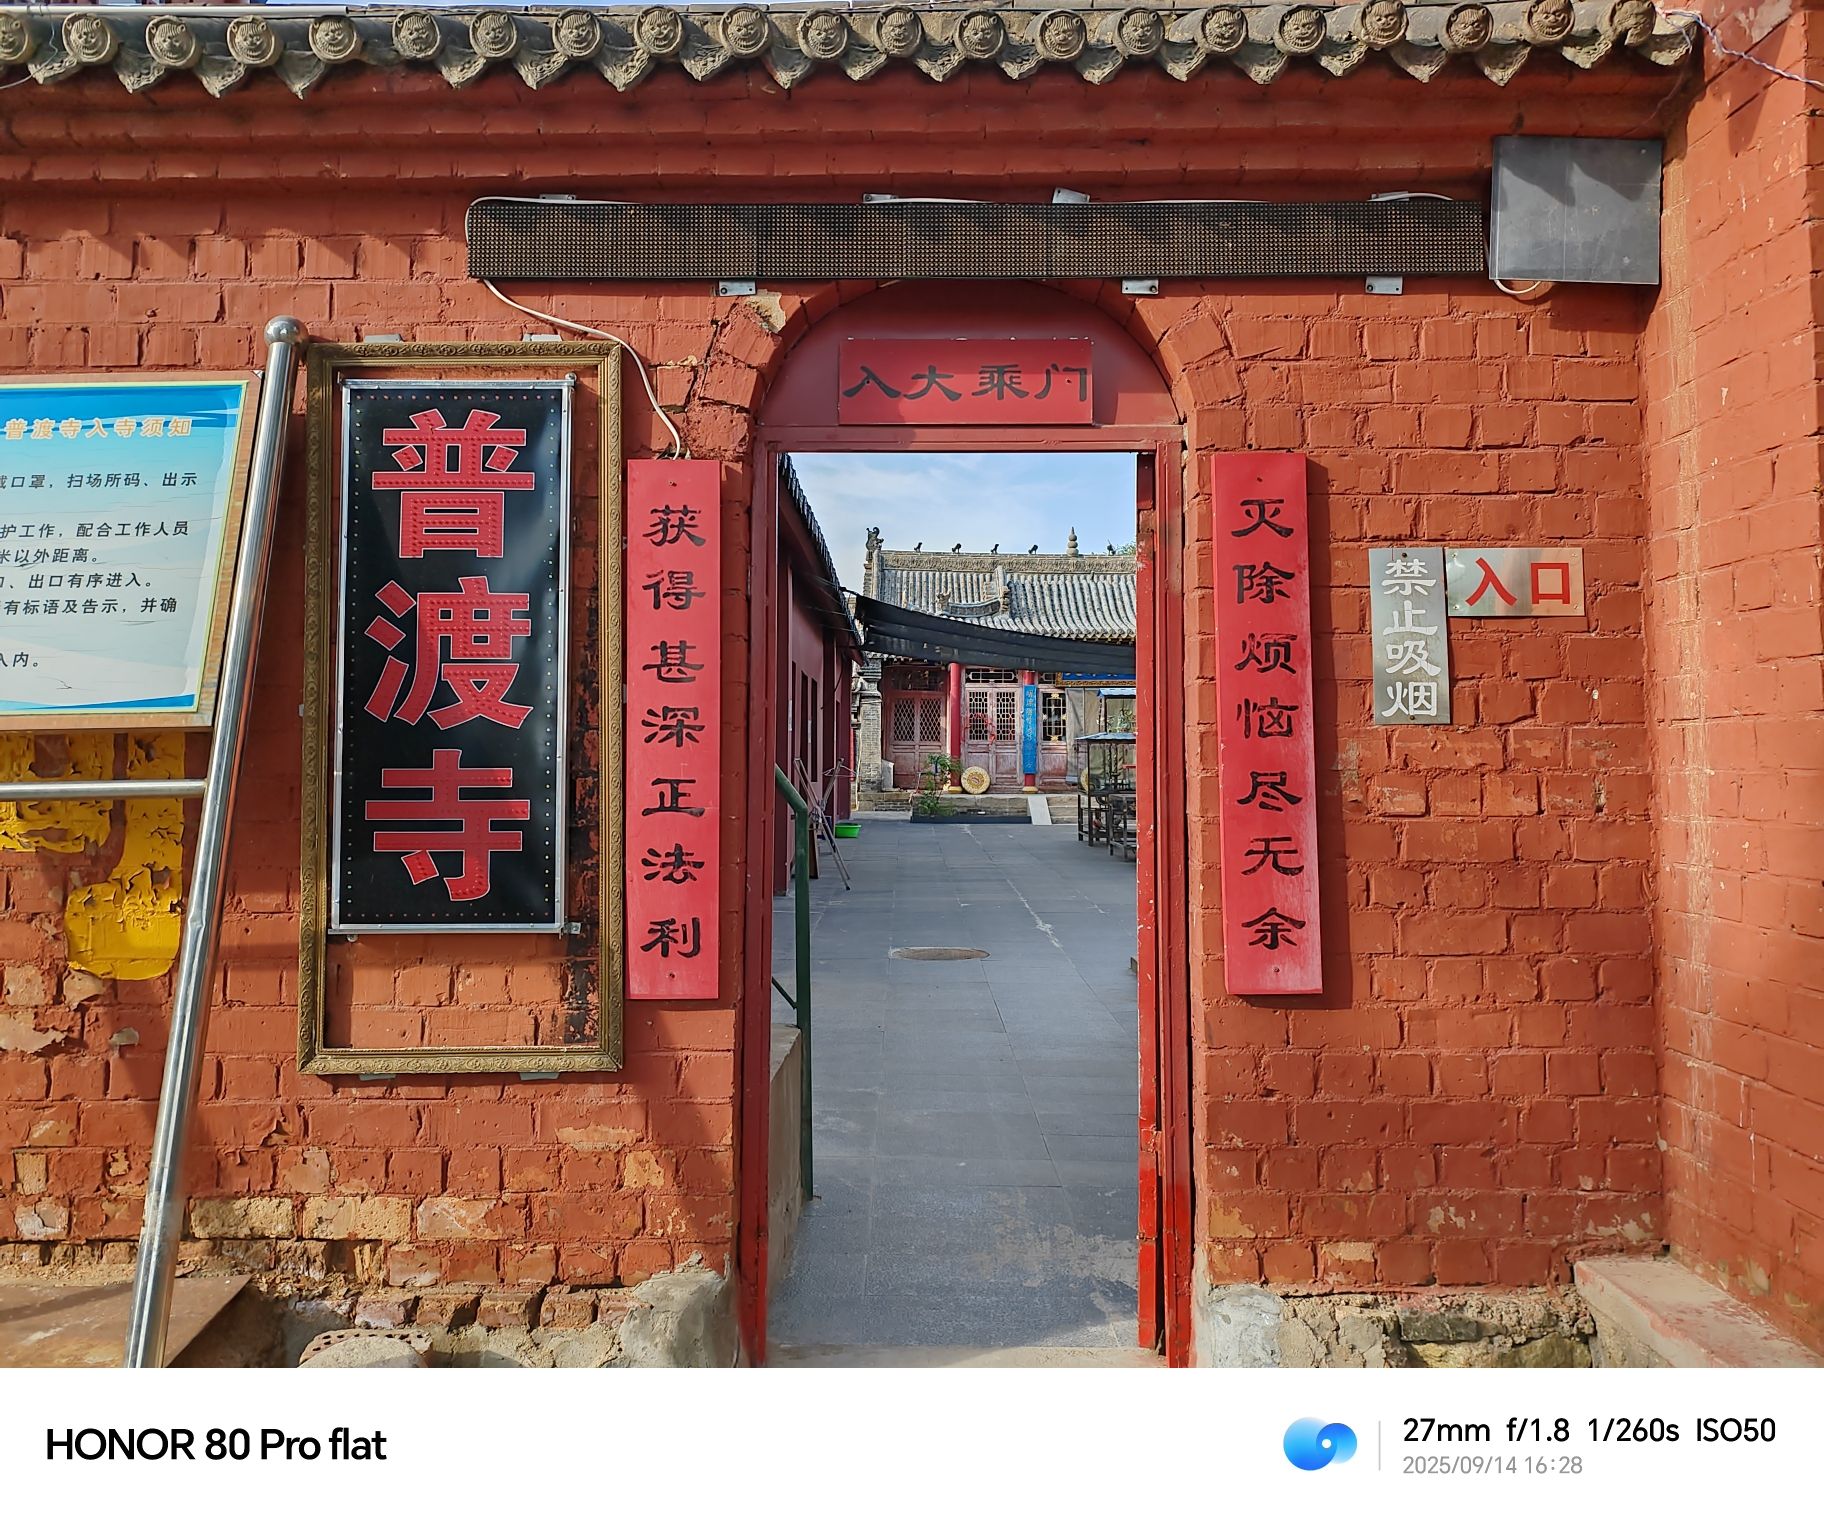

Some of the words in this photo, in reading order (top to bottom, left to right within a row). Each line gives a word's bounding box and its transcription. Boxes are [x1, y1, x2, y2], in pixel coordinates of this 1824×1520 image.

[842, 363, 1088, 402] 入大乘门
[5, 417, 193, 440] 普渡寺入寺须知
[0, 521, 190, 539] 护工作，配合工作人员
[1464, 556, 1571, 606] 入口
[3, 597, 178, 616] 有标语及告示，并确
[363, 408, 537, 902] 普渡寺
[1380, 558, 1442, 718] 禁止吸烟
[640, 504, 707, 961] 获得甚深正法利
[1230, 498, 1306, 952] 灭除烦恼尽无余
